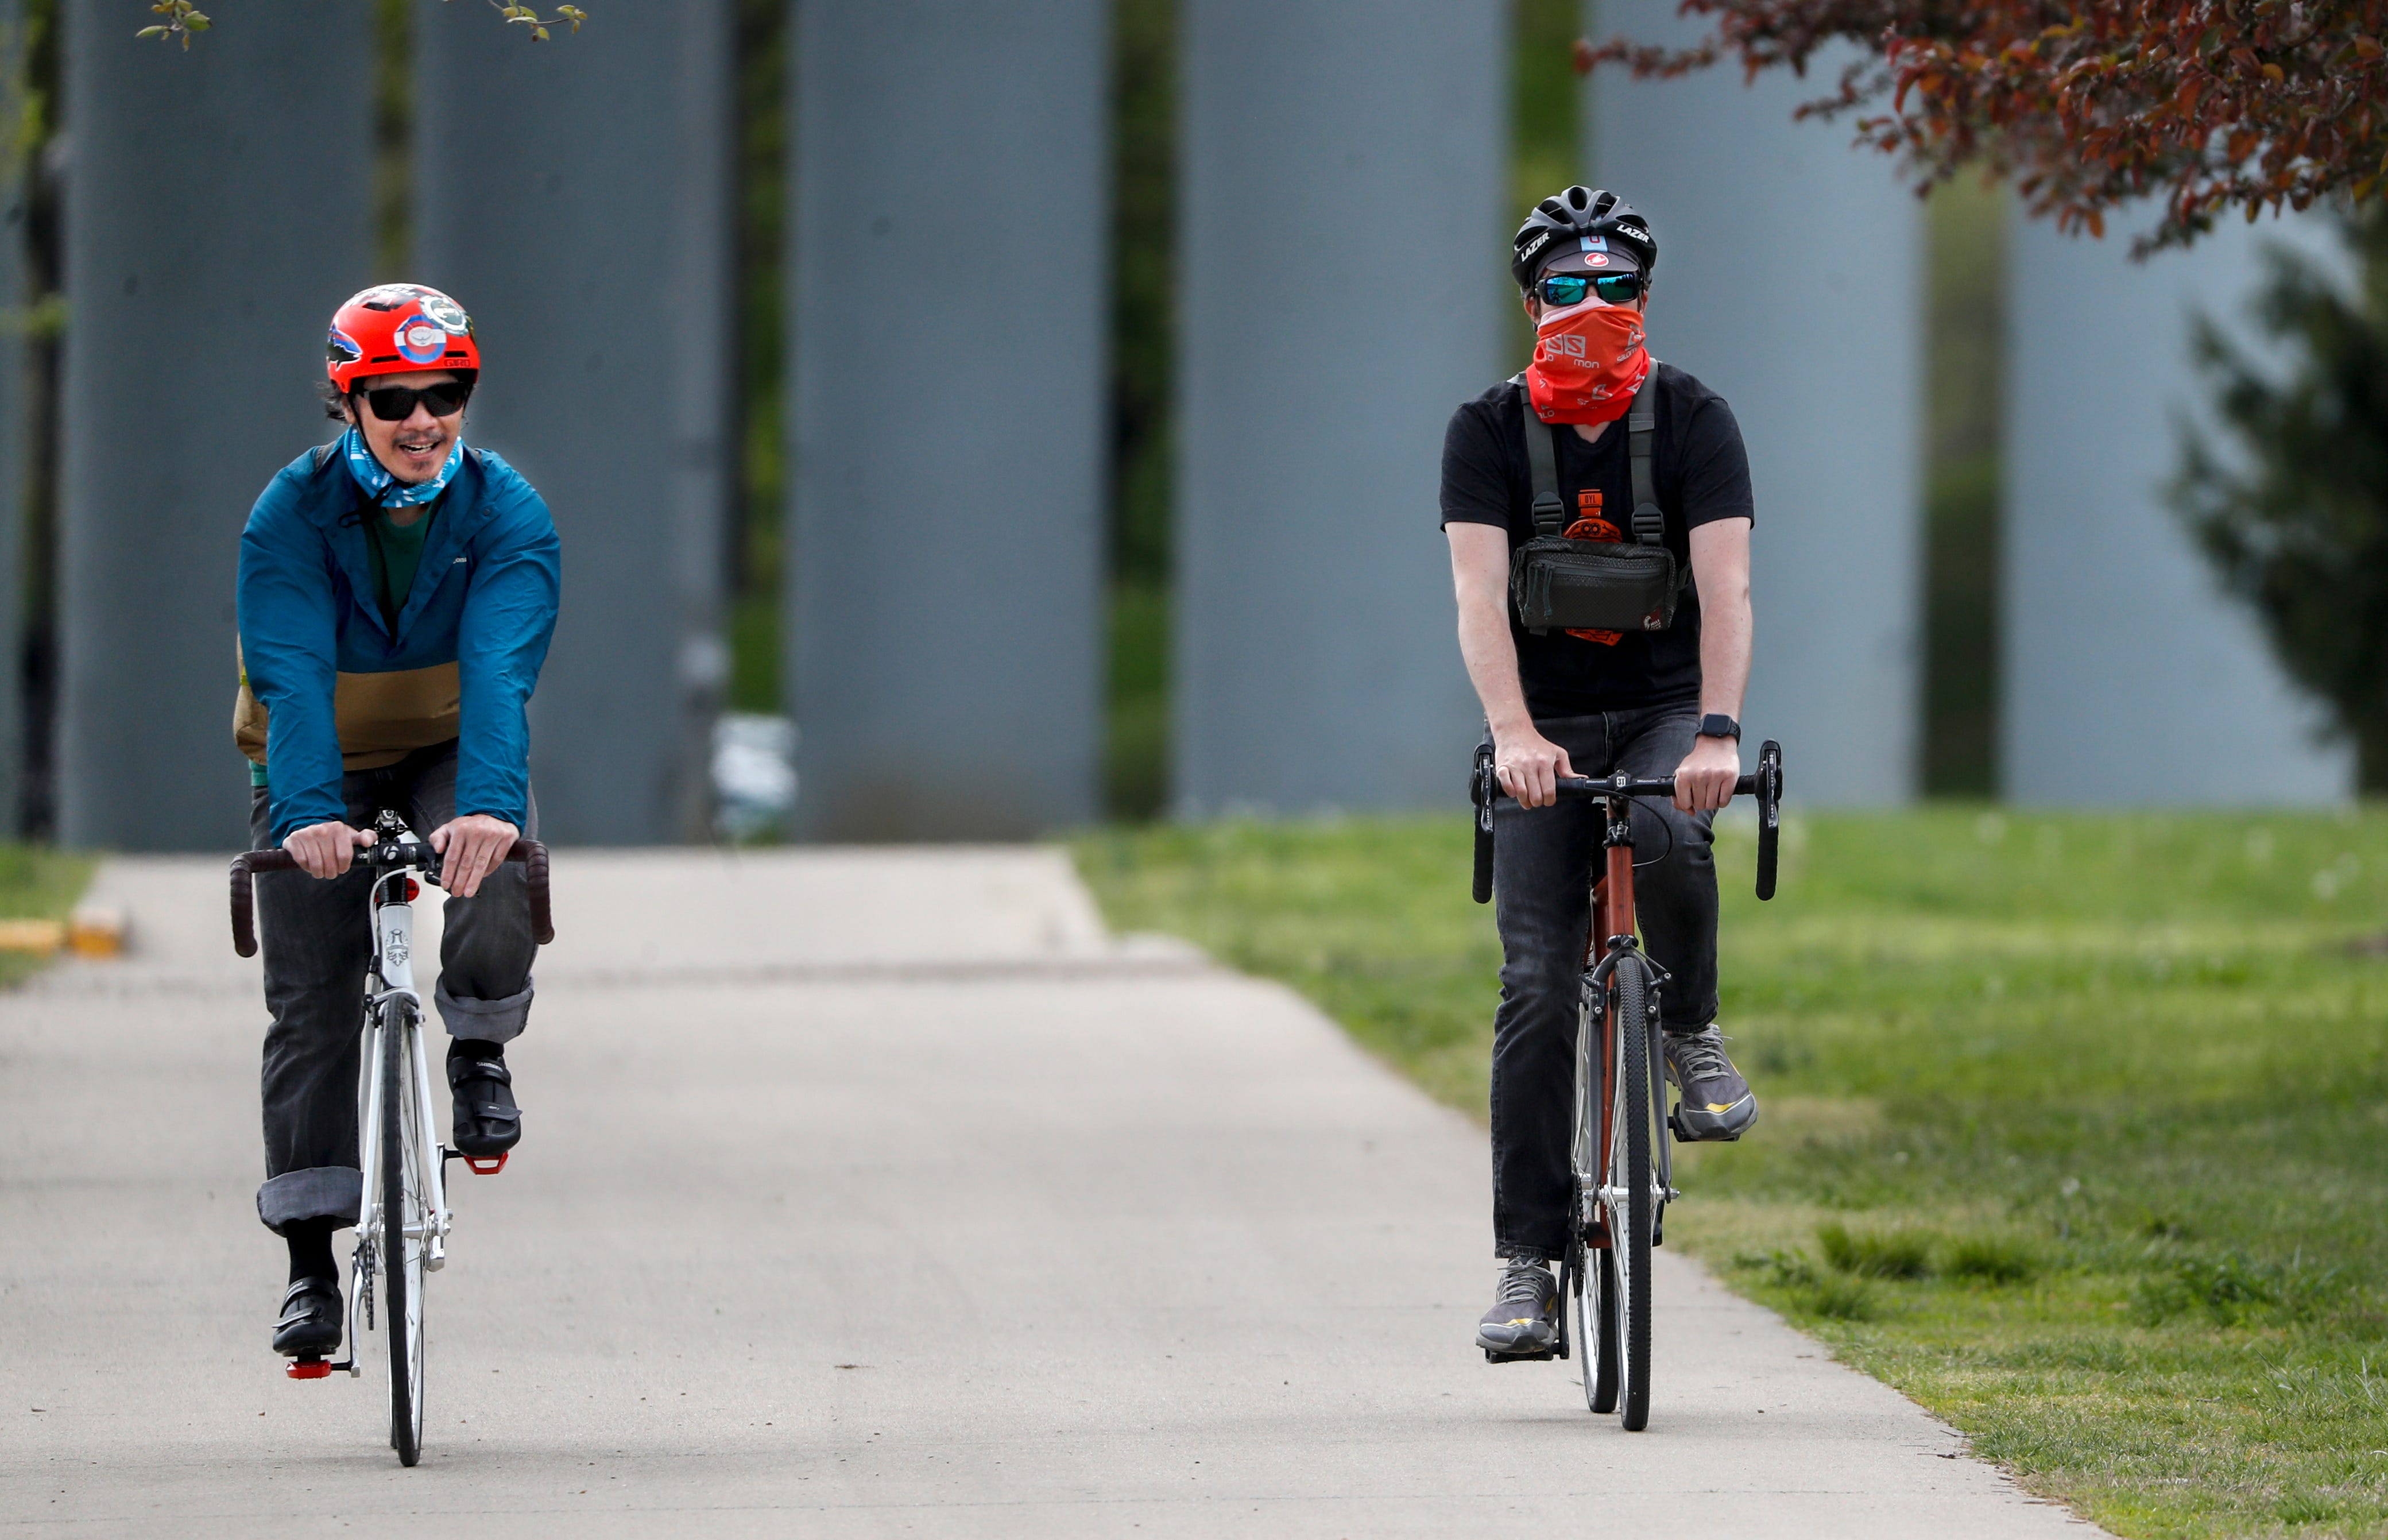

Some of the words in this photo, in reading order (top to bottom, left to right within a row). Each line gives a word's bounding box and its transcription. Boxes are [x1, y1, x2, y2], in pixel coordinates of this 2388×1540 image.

[1617, 225, 1649, 243] LAZER
[1521, 232, 1550, 262] LAZER
[1574, 359, 1599, 369] mon
[1617, 777, 1625, 786] 3T
